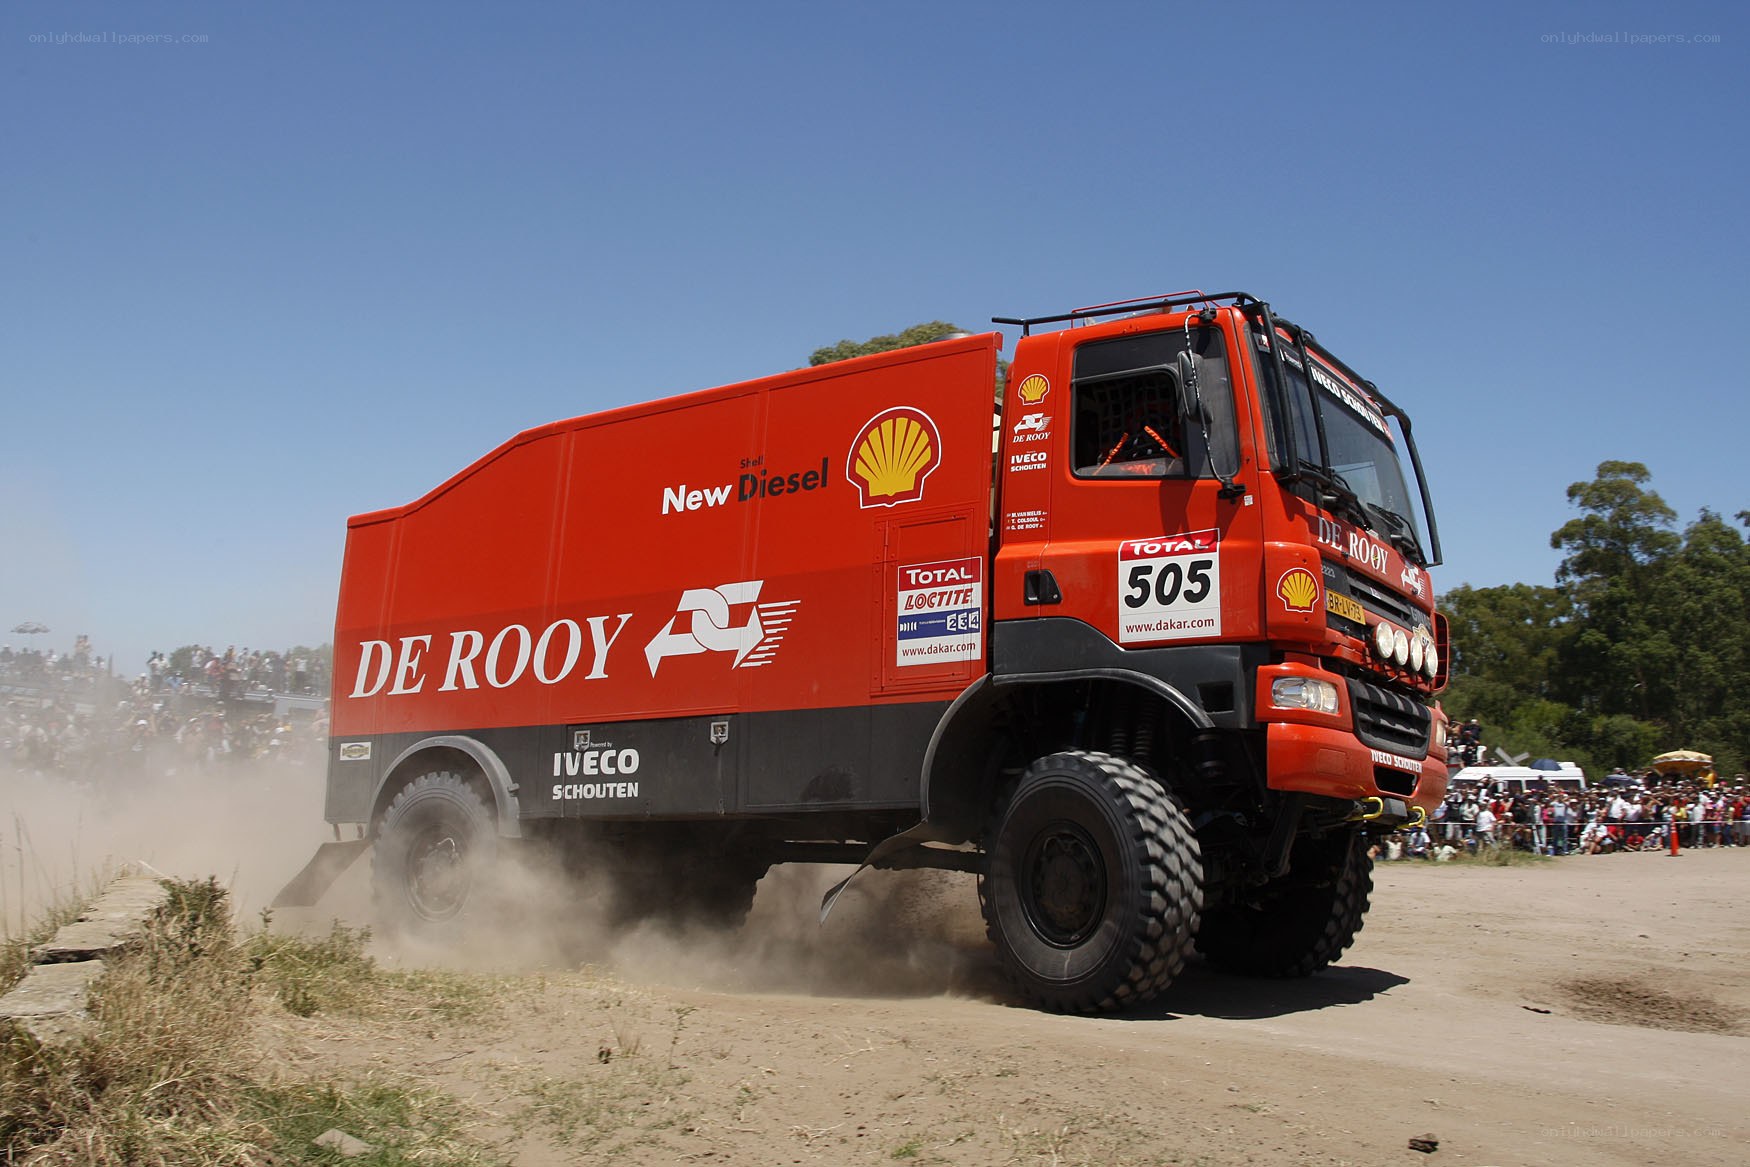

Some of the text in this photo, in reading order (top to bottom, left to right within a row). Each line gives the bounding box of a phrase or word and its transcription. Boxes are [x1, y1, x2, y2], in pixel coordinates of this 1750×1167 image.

[1310, 365, 1341, 398] IVECO
[1012, 431, 1051, 443] DE ROOY
[739, 455, 765, 469] Shell
[1010, 451, 1047, 465] IVECO
[1010, 463, 1047, 472] SCHOUTEN
[661, 456, 829, 515] New Diesel
[1129, 539, 1209, 556] TOTAL
[1317, 516, 1388, 575] DE ROOY
[905, 566, 974, 585] TOTAL
[1124, 559, 1213, 609] 505
[904, 587, 974, 611] LOCTITE
[1125, 618, 1215, 634] www.dakar.com
[348, 612, 633, 699] DE ROOY
[902, 642, 976, 657] www.dakar.com
[589, 741, 607, 749] Powered
[553, 748, 640, 777] IVECO
[1370, 749, 1424, 774] IVECO SCHOUTEN
[552, 782, 639, 800] SCHOUTEN
